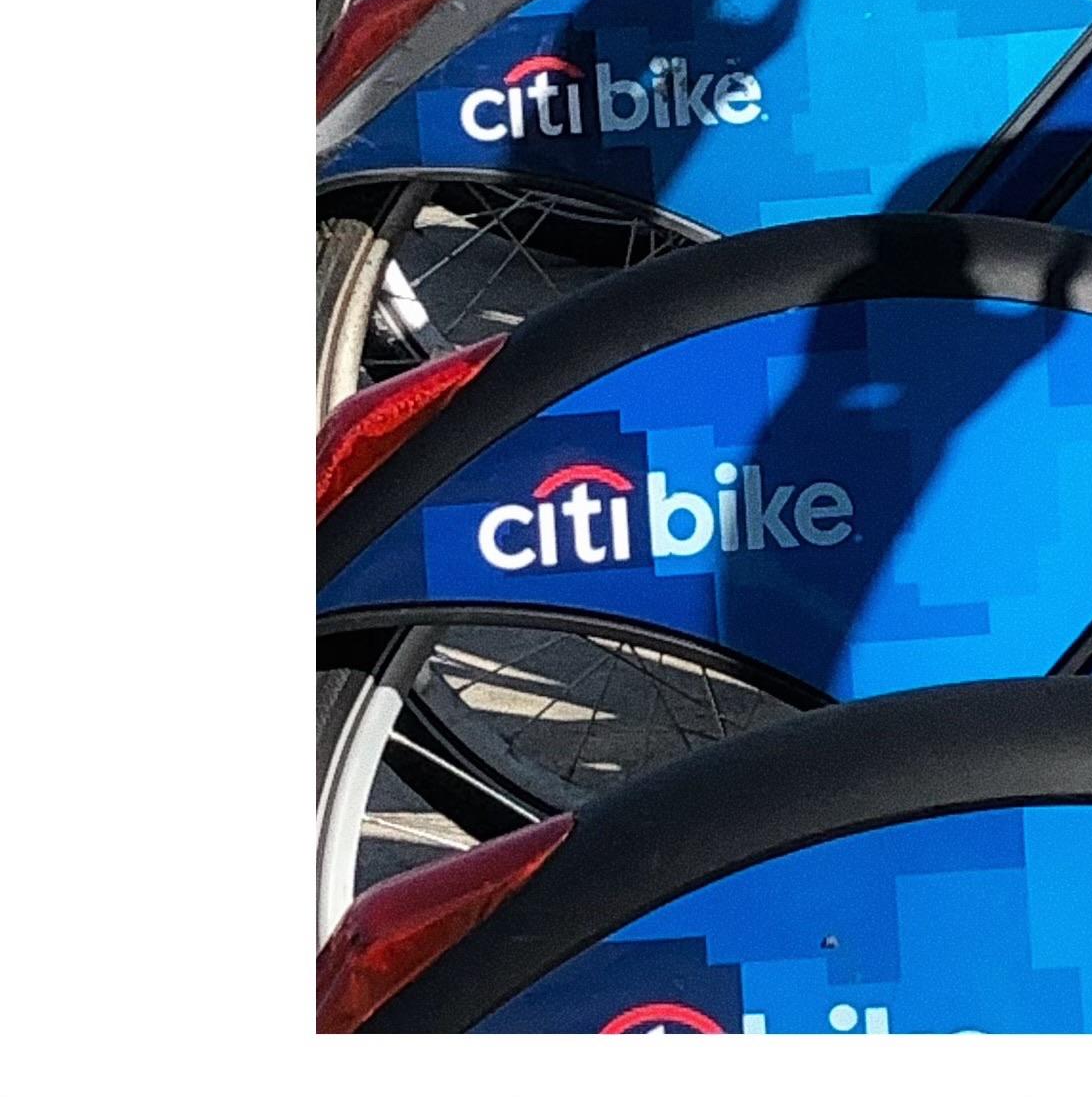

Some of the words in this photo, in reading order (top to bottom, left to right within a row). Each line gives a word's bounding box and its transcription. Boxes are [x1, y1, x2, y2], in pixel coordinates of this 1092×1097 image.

[460, 55, 584, 142] citi
[595, 56, 763, 132] bike
[477, 463, 635, 571] citi
[646, 462, 853, 558] bike
